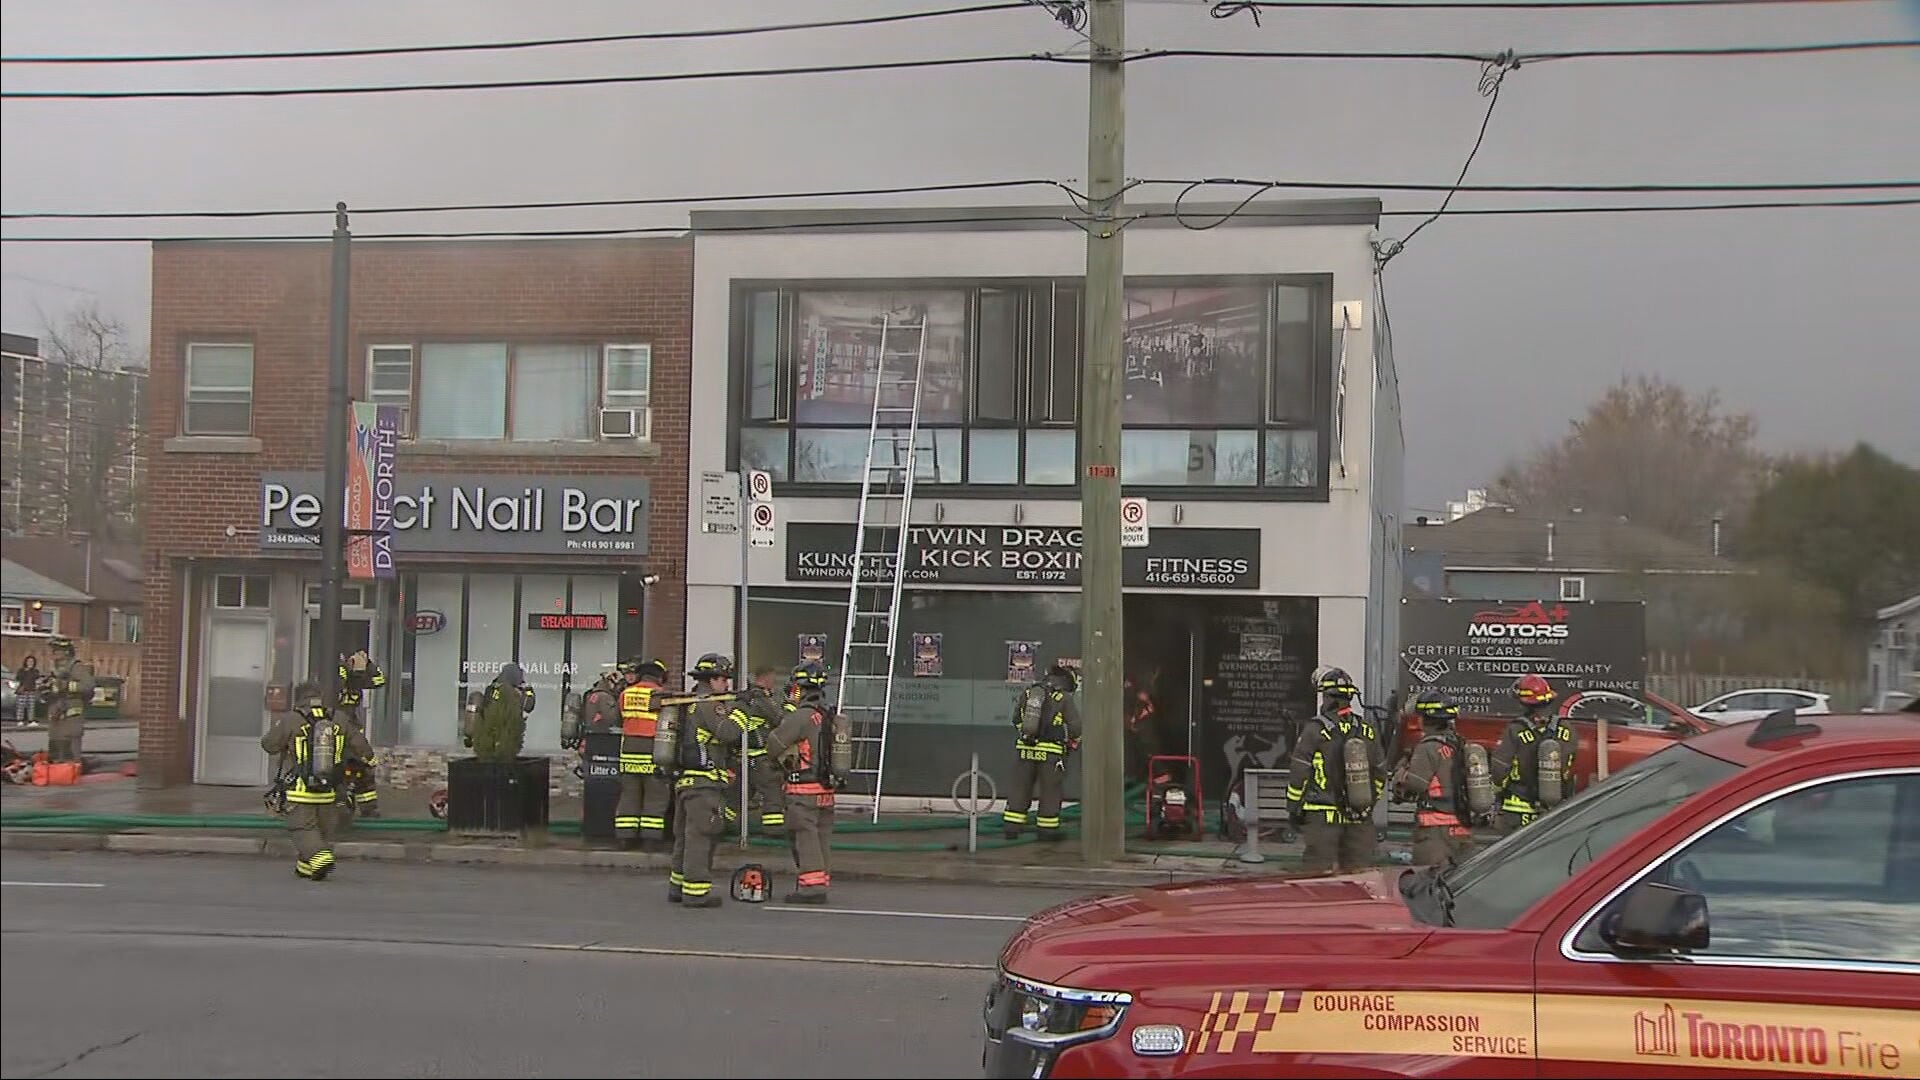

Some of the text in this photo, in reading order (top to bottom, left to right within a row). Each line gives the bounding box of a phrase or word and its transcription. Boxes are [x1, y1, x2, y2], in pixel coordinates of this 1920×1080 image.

[376, 428, 395, 569] DANFORTH
[263, 484, 642, 533] Pect Nail Bar
[351, 476, 362, 568] CROSROADS
[566, 539, 581, 549] Ph:
[581, 540, 597, 549] 416
[598, 541, 613, 550] 901
[908, 527, 1083, 547] TWIN DRAG
[1123, 534, 1145, 543] ROUTE
[920, 549, 993, 568] KICK
[1001, 550, 1083, 569] BOXI
[1146, 558, 1249, 574] FITNESS
[798, 567, 1236, 585] TWINDRAONEAT.COM EST. 1972 416-691-5600
[541, 616, 575, 629] EYELASH
[1467, 623, 1569, 638] MOTORS
[1513, 637, 1535, 646] USED
[1408, 645, 1523, 657] CERTIFIED CARS
[554, 663, 578, 675] BAR
[1457, 662, 1612, 674] EXTENDED WARRANTY
[1440, 686, 1491, 694] DANFORTH
[1566, 679, 1640, 690] WE FINANCE
[1313, 995, 1395, 1012] COURAGE
[1364, 1014, 1480, 1032] COMPASSION
[1453, 1035, 1528, 1055] SERVICE
[1681, 1012, 1900, 1071] TORONTO Fire
